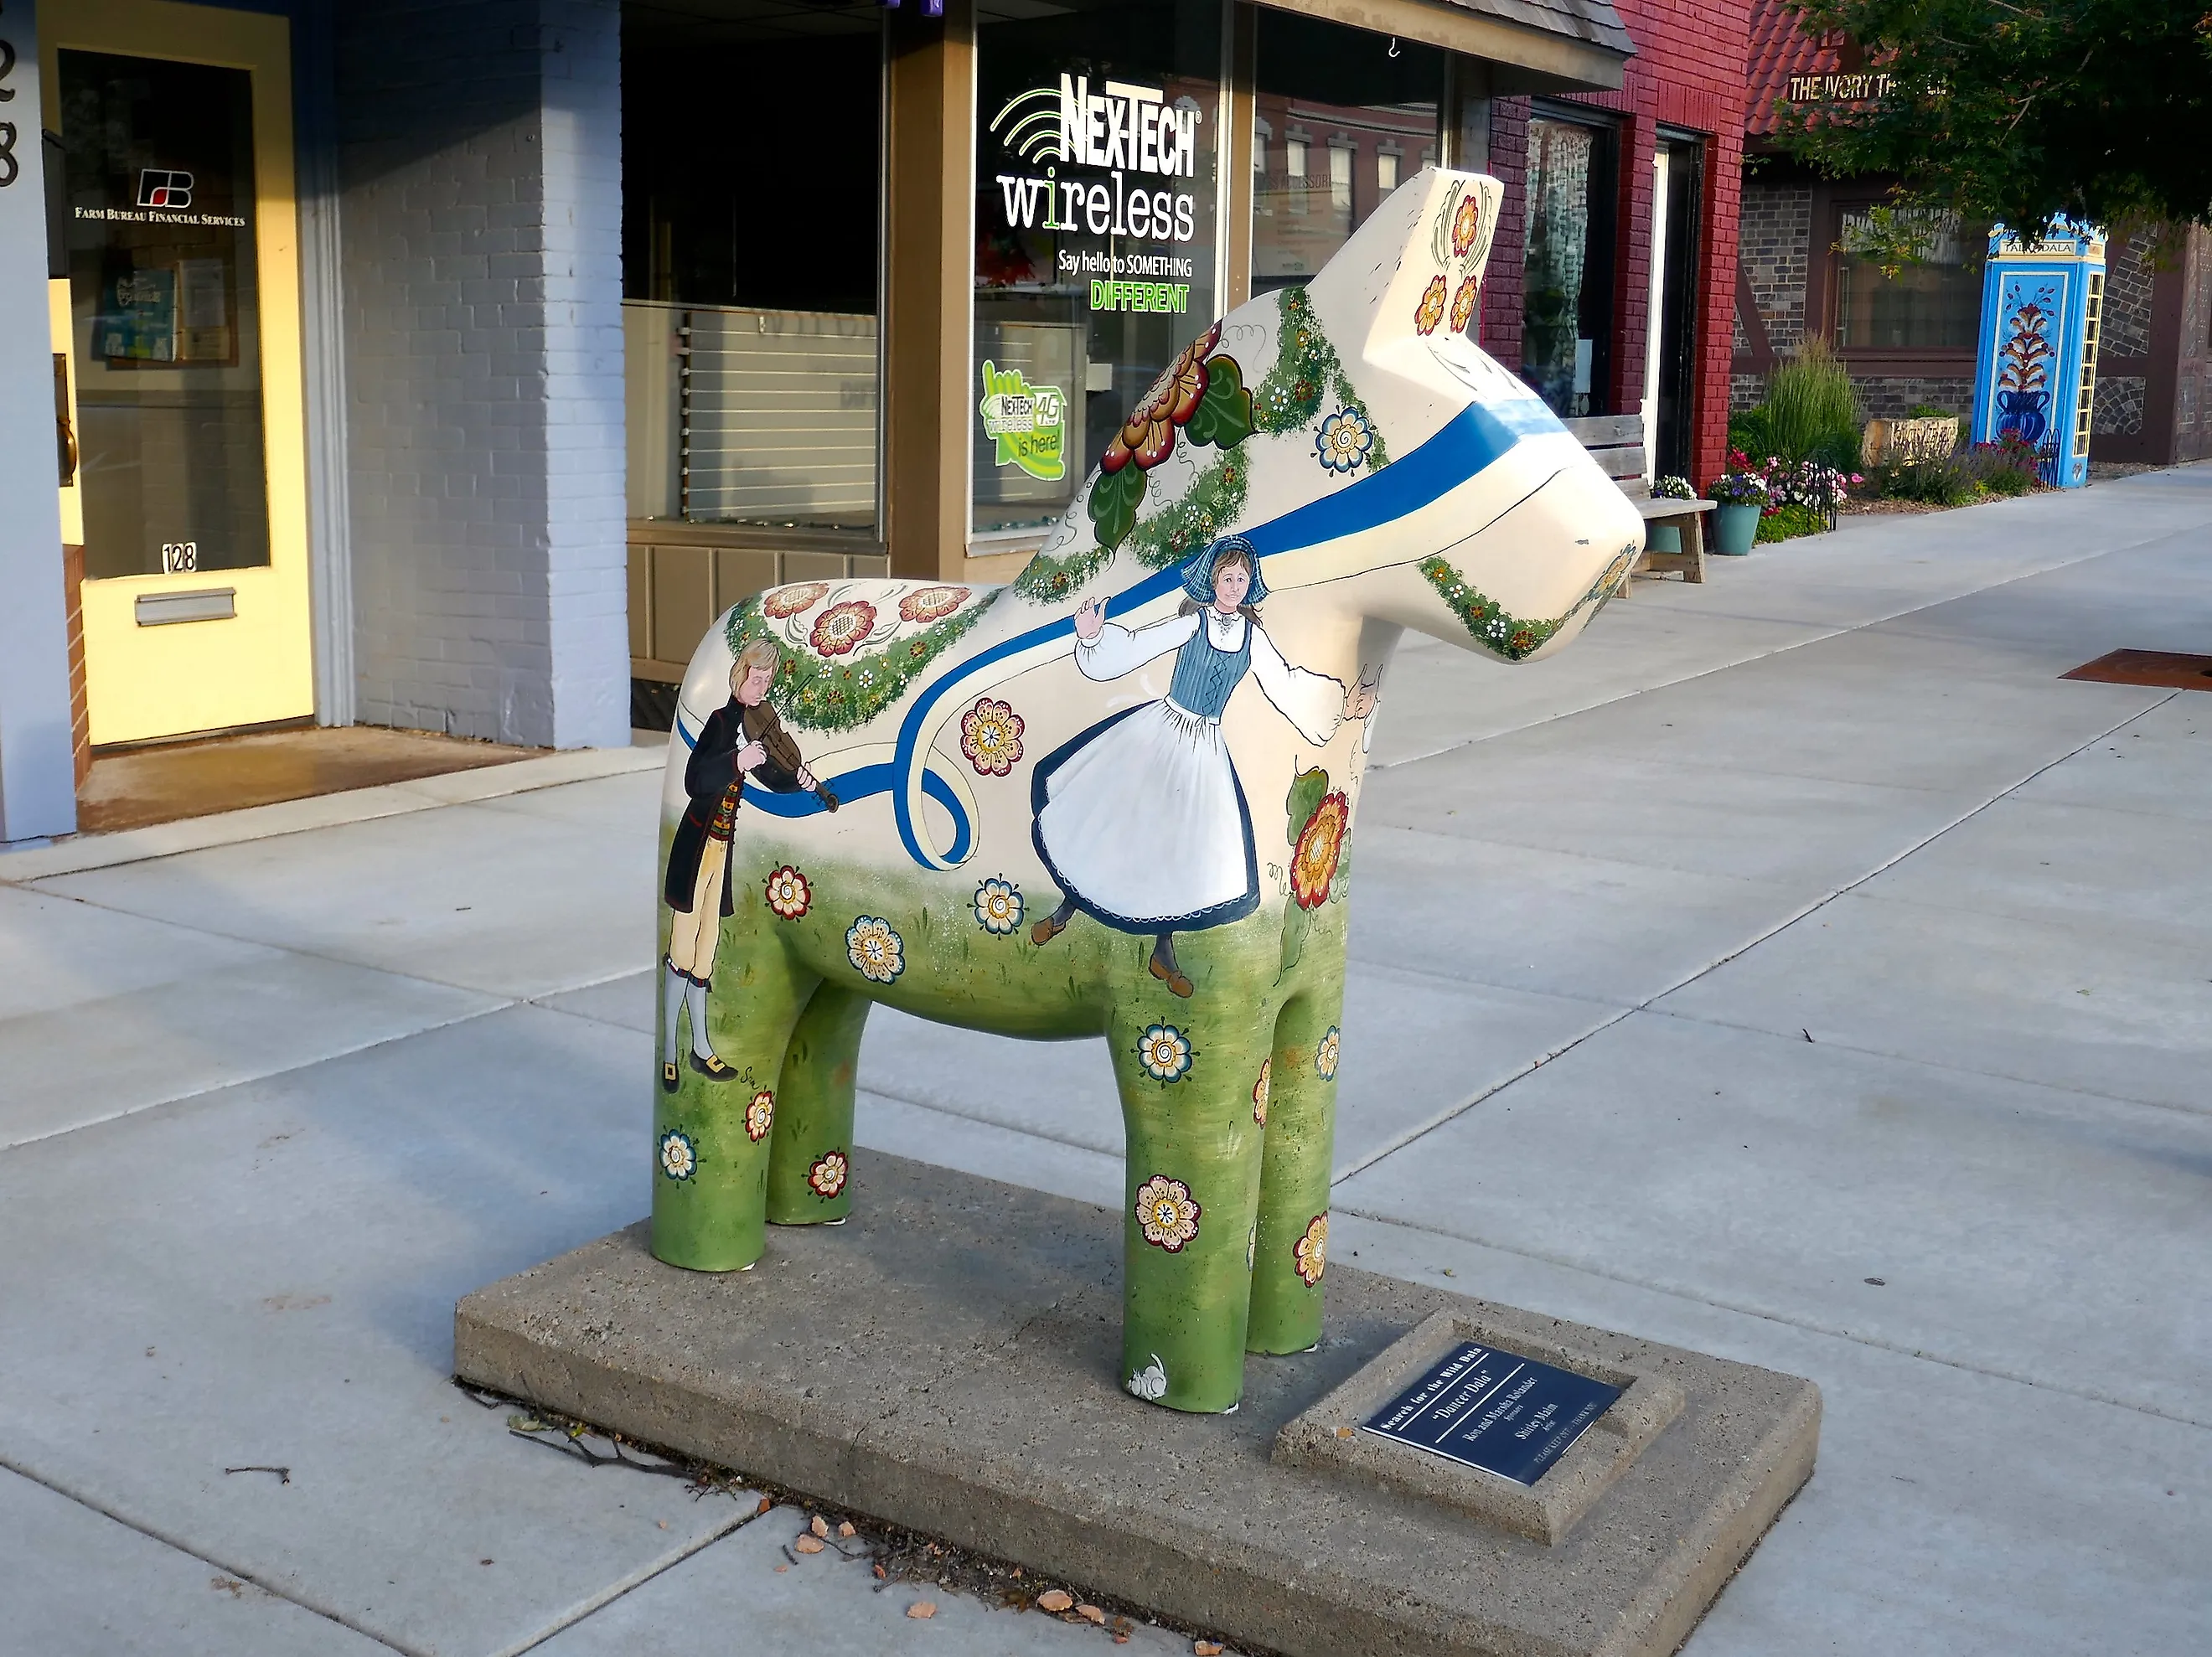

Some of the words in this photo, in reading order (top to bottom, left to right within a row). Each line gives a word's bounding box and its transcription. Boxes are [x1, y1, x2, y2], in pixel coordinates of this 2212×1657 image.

[1791, 76, 1822, 101] THE
[75, 207, 105, 219] FARM
[106, 209, 147, 222] BUREAU
[148, 211, 200, 225] FINANCIAL
[201, 214, 245, 227] SERVICES
[996, 167, 1194, 242] wireless
[2043, 244, 2071, 252] DALA
[1058, 250, 1082, 276] Say
[1082, 250, 1110, 273] hello
[1111, 256, 1125, 275] to
[1126, 255, 1192, 277] SOMETHING
[1091, 279, 1190, 313] DIFFERENT
[1037, 395, 1059, 425] 4G
[989, 418, 1033, 432] wireless
[1018, 437, 1028, 457] is
[1031, 430, 1060, 454] here!
[163, 545, 195, 573] 128
[1380, 1404, 1414, 1430] Search
[1410, 1391, 1428, 1405] for
[1427, 1379, 1444, 1391] the
[1439, 1362, 1464, 1378] Wild
[1458, 1347, 1482, 1363] Dala
[1481, 1417, 1494, 1430] and
[1485, 1400, 1513, 1421] Marsha
[1514, 1417, 1543, 1440] Shirley
[1534, 1402, 1558, 1421] Malm
[1462, 1426, 1482, 1442] Ron
